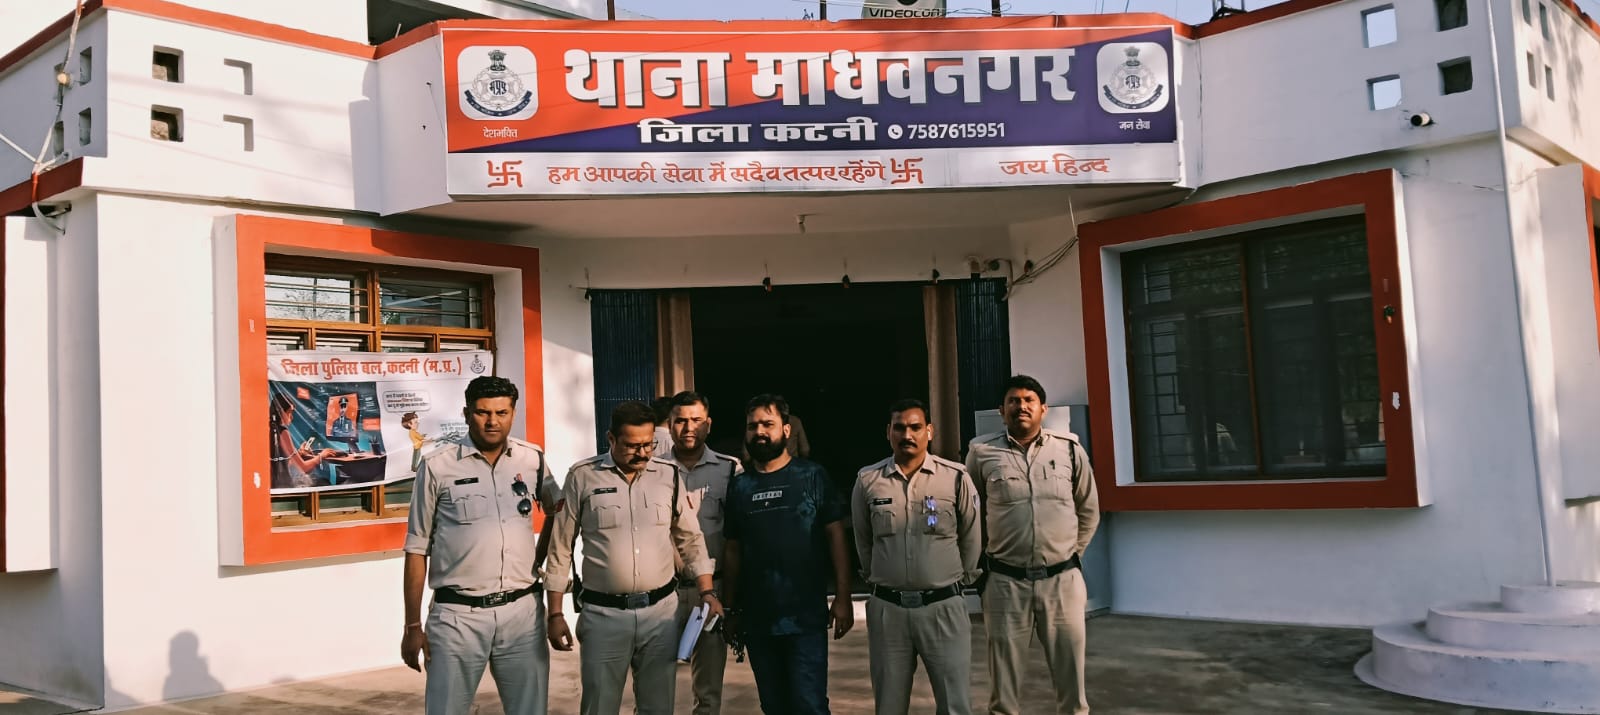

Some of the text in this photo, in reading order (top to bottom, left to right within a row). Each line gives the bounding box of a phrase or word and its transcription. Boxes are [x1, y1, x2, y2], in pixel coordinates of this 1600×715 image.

[868, 8, 940, 18] VIDEOCON
[564, 48, 1076, 108] थाना माधवनगर
[637, 116, 1006, 144] जिला कटनी 7587615951
[546, 166, 581, 184] हम
[584, 161, 658, 184] आपकी
[661, 162, 706, 183] सेवा
[707, 160, 728, 183] में
[729, 160, 782, 183] सदैव
[782, 166, 838, 182] तत्पर
[999, 153, 1111, 176] जय हिन्द
[281, 358, 319, 376] जिला
[321, 357, 359, 381] पुलिस
